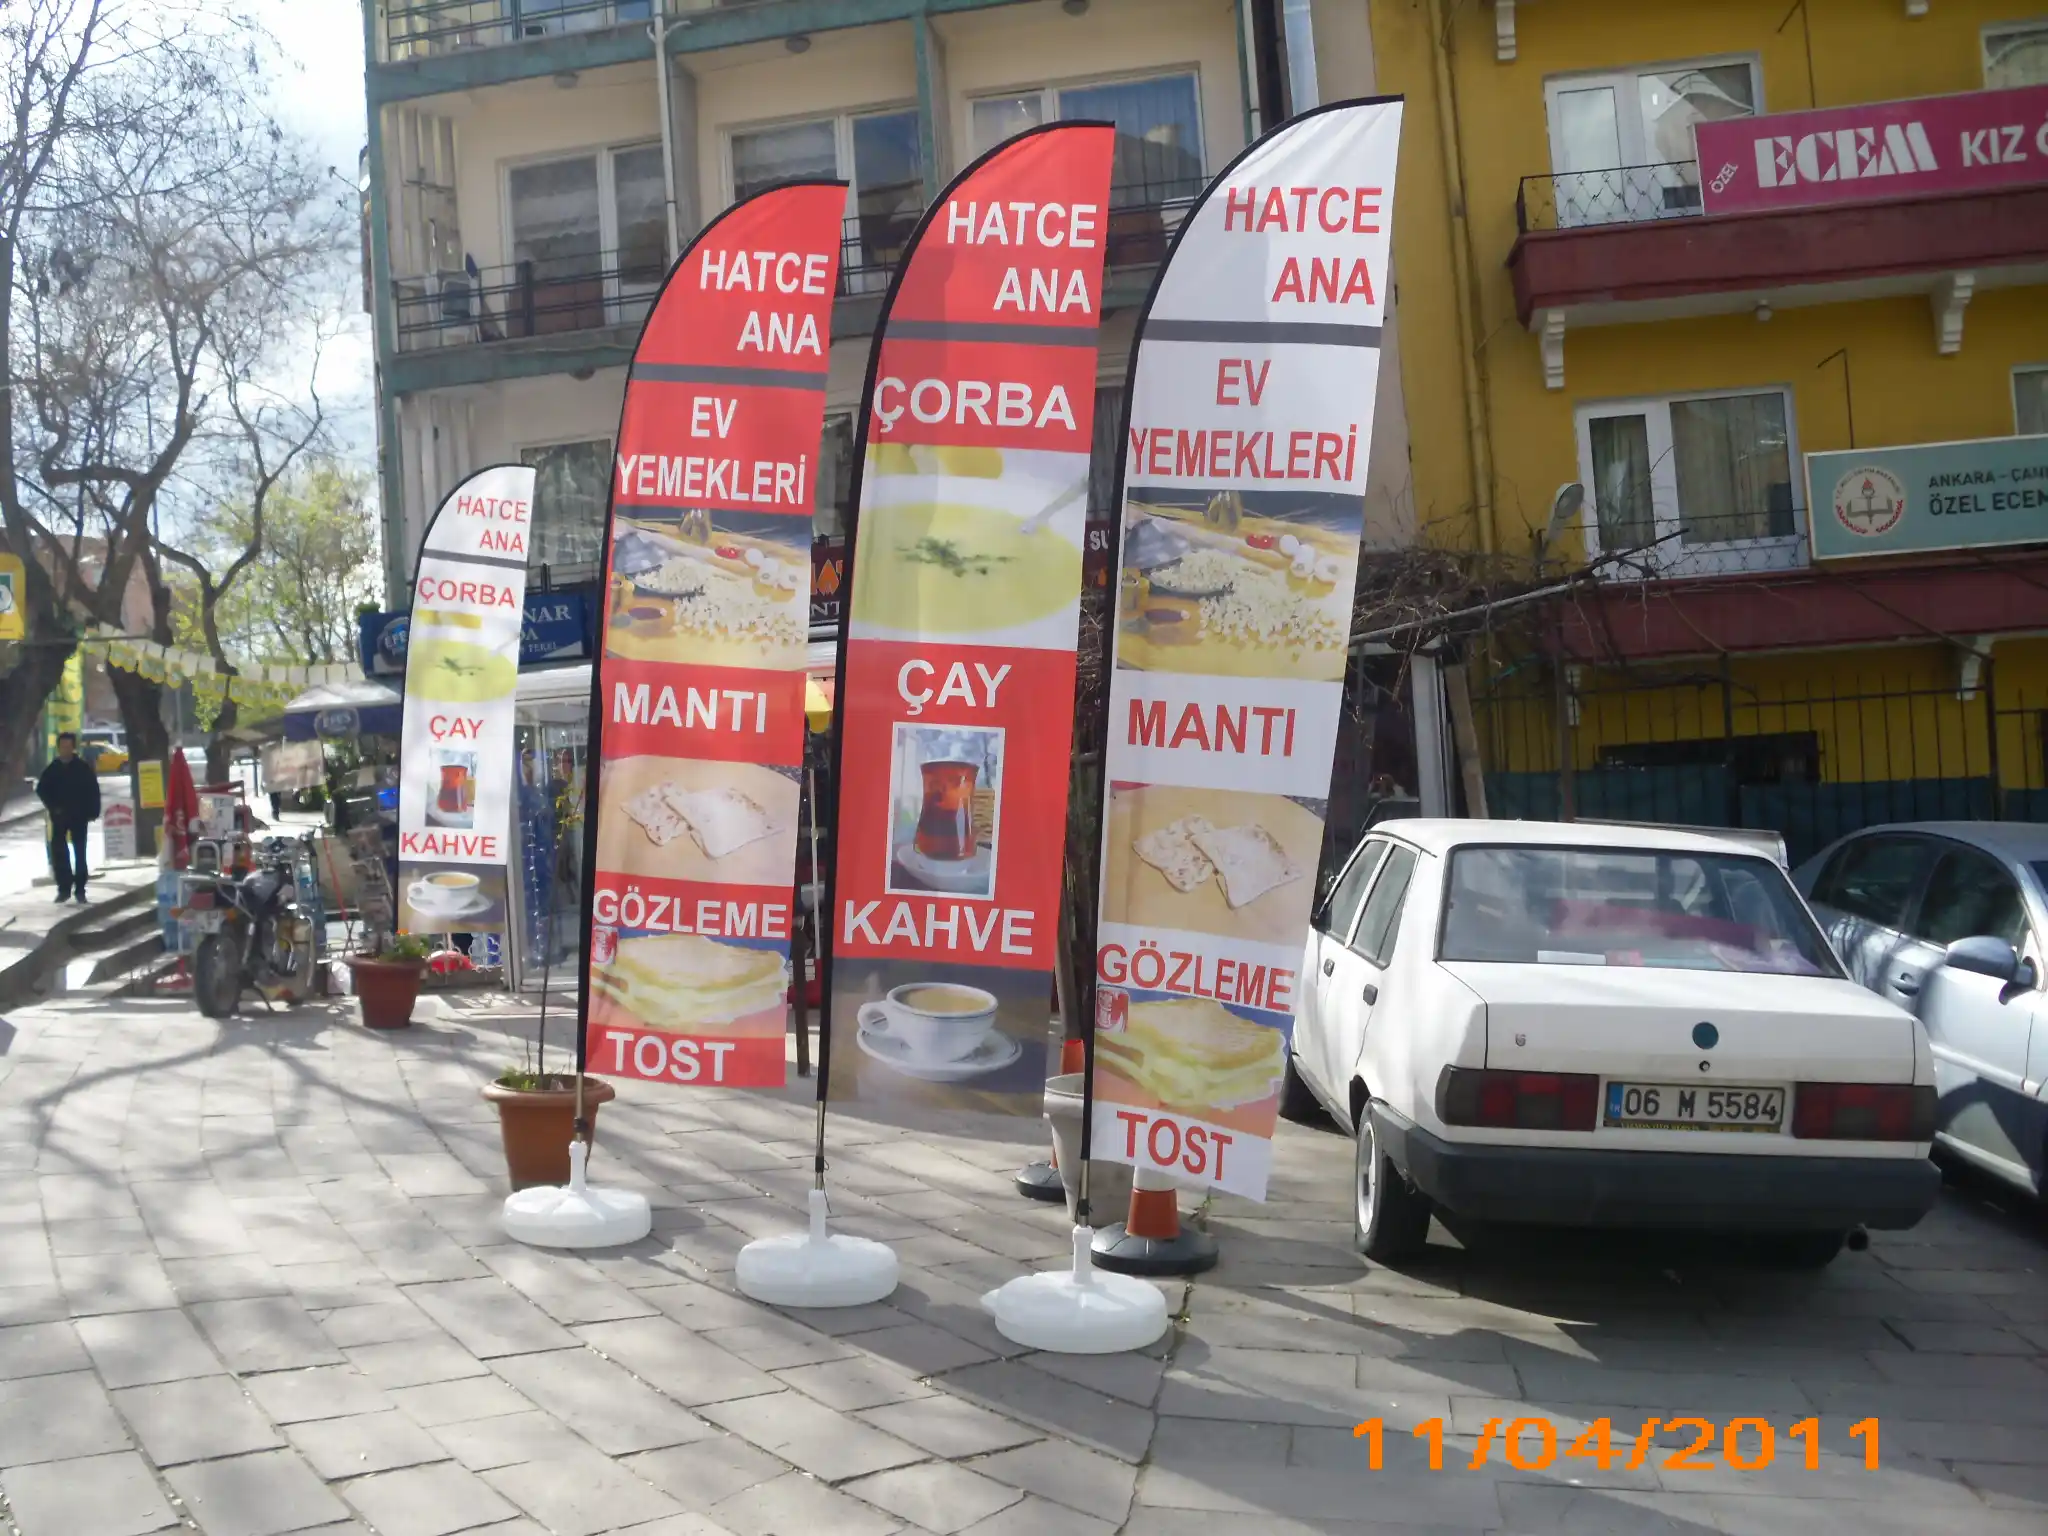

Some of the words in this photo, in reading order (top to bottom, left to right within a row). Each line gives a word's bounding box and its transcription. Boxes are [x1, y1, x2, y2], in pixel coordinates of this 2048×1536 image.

[1710, 162, 1739, 194] ÖZEL
[1754, 121, 1939, 188] ECEM
[1960, 124, 2028, 167] KIZ
[947, 201, 1097, 248] HATCE
[1224, 186, 1382, 233] HATCE
[700, 249, 829, 294] HATCE
[993, 267, 1091, 313] ANA
[1271, 257, 1375, 305] ANA
[736, 311, 821, 355] ANA
[873, 377, 1077, 432] ÇORBA
[1216, 358, 1271, 406] EV
[691, 396, 737, 438] EV
[1129, 424, 1357, 482] YEMEKLERİ
[617, 454, 806, 504] YEMEKLERİ
[1929, 473, 1995, 489] ANKARA
[457, 495, 528, 522] HATCE
[1929, 493, 1986, 516] ÖZEL
[480, 529, 523, 553] ANA
[418, 576, 515, 608] ÇORBA
[613, 682, 766, 733] MANTI
[897, 659, 1011, 715] ÇAY
[429, 715, 484, 742] ÇAY
[1128, 699, 1295, 756] MANTI
[401, 831, 497, 857] KAHVE
[593, 885, 787, 937] GÖZLEME
[843, 900, 1035, 955] KAHVE
[1096, 940, 1295, 1012] GÖZLEME
[606, 1031, 735, 1082] TOST
[1625, 1088, 1660, 1116] 06
[1678, 1090, 1696, 1118] M
[1708, 1091, 1777, 1121] 5584
[1117, 1110, 1233, 1181] TOST
